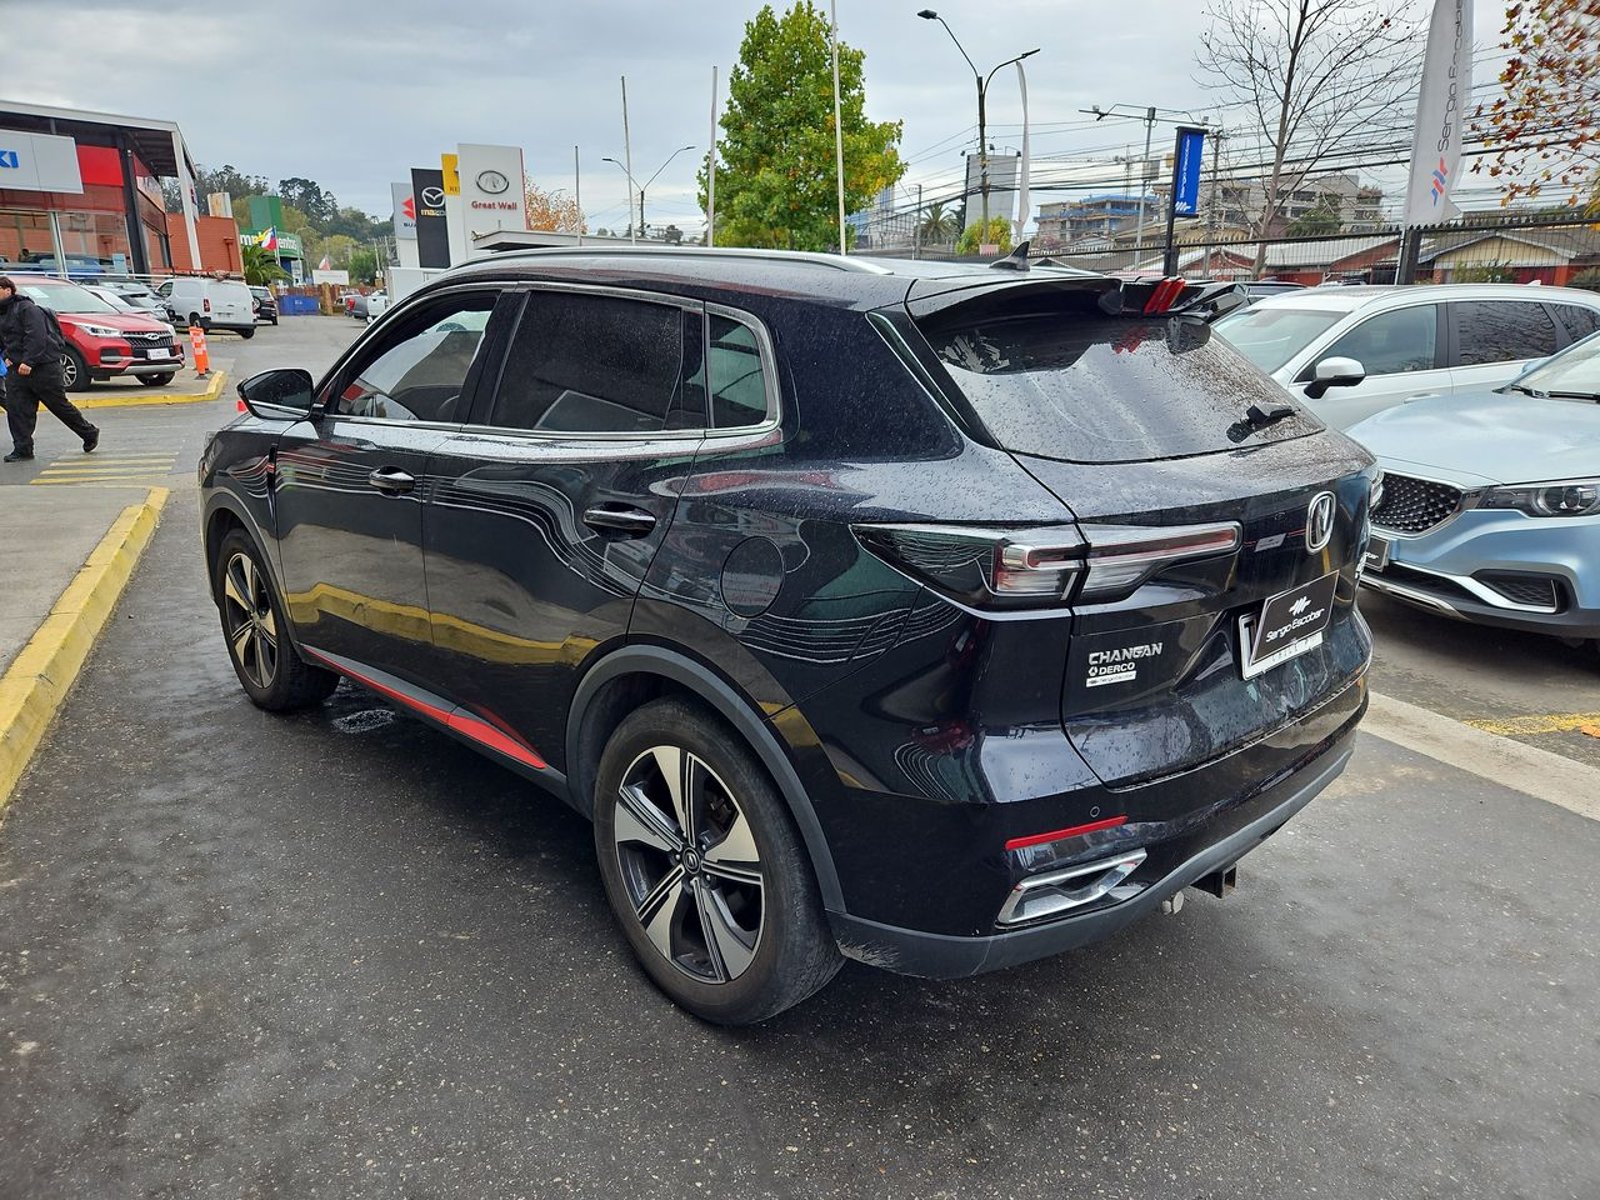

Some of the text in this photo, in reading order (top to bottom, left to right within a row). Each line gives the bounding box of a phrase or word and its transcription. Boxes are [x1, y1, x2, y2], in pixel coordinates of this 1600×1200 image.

[471, 201, 517, 210] Great Wall
[1292, 608, 1325, 629] Escobar
[1089, 642, 1163, 665] CHANGAN
[1099, 662, 1136, 675] DERCO
